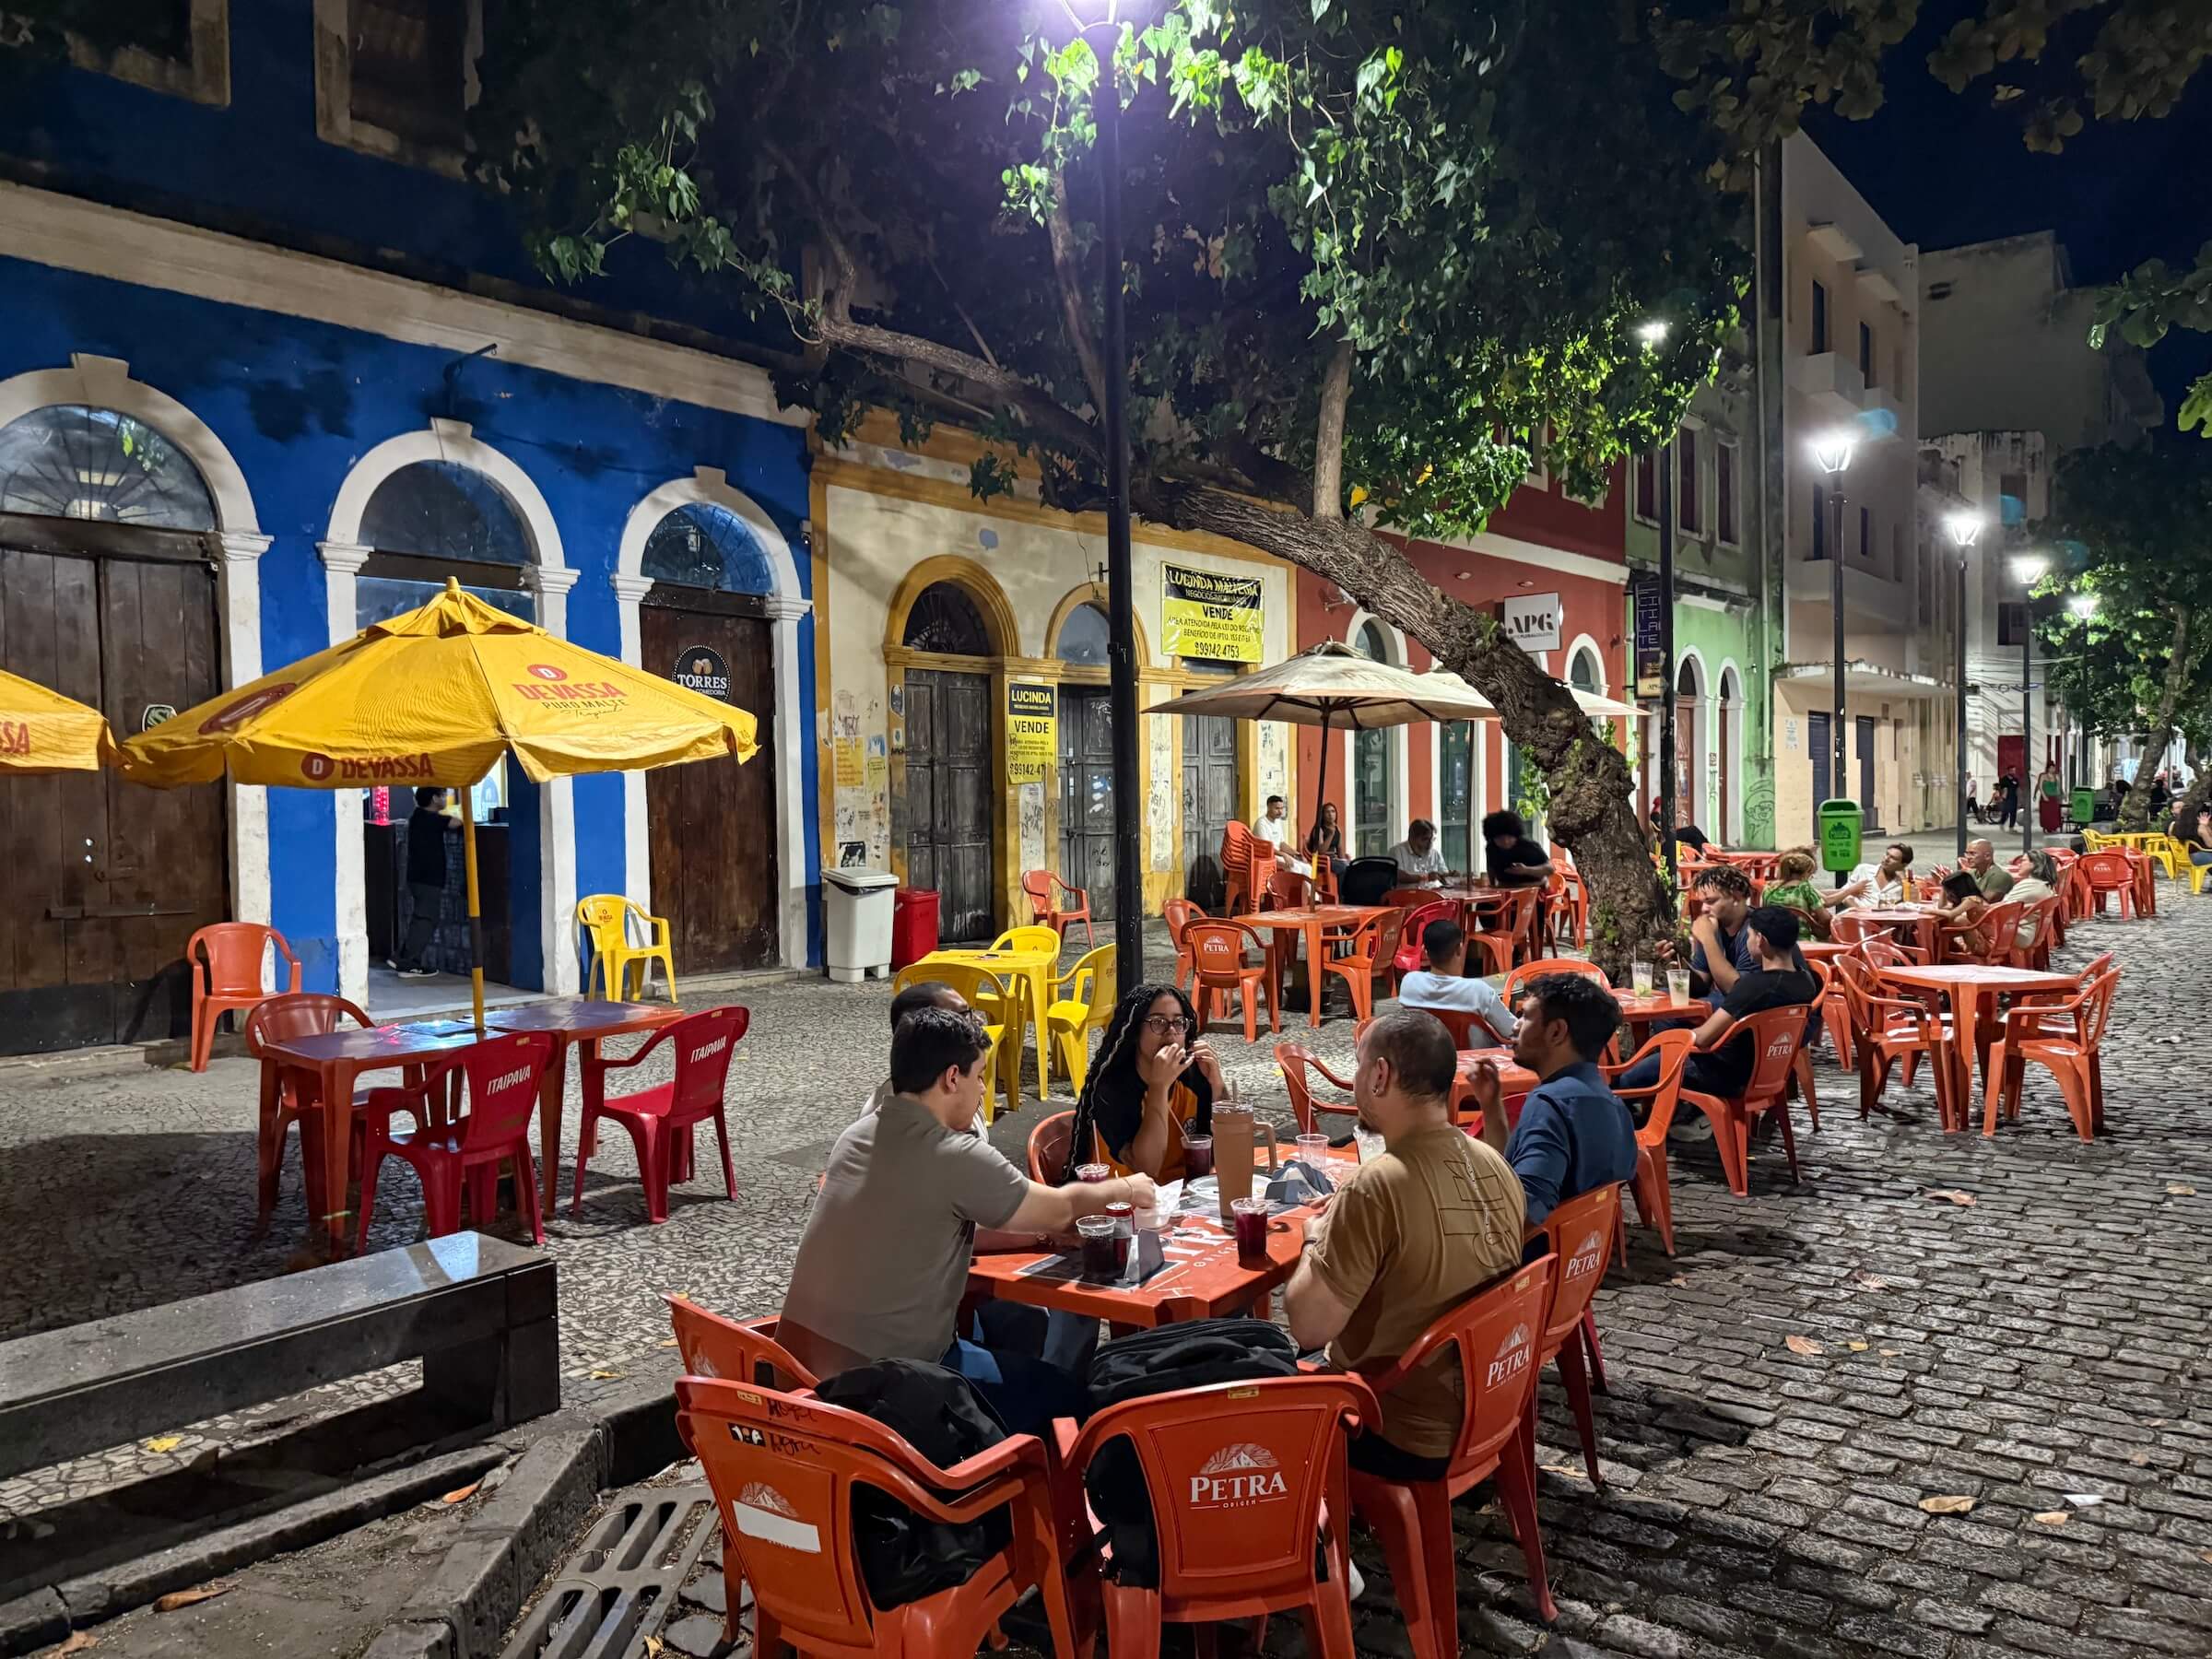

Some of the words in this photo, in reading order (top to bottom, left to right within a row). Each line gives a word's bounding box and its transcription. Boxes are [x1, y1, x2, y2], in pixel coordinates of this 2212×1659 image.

[1169, 570, 1213, 591] LUCINDA
[1202, 605, 1233, 620] VENDE
[677, 674, 727, 689] TORRES
[512, 682, 628, 700] DEVASSA
[1011, 689, 1052, 704] LUCINDA
[542, 700, 581, 710] PURO
[582, 699, 629, 708] MALTE
[1014, 720, 1050, 735] VENDE
[339, 752, 435, 779] DEVASSA
[1203, 943, 1230, 952] PETRA
[690, 1035, 726, 1064] ITAIPAVA
[1766, 1044, 1793, 1057] PETRA
[487, 1065, 532, 1096] ITAIPAVA
[1565, 1250, 1601, 1279] PETRA
[1486, 1343, 1530, 1387] PETRA
[1189, 1471, 1288, 1503] PETRA
